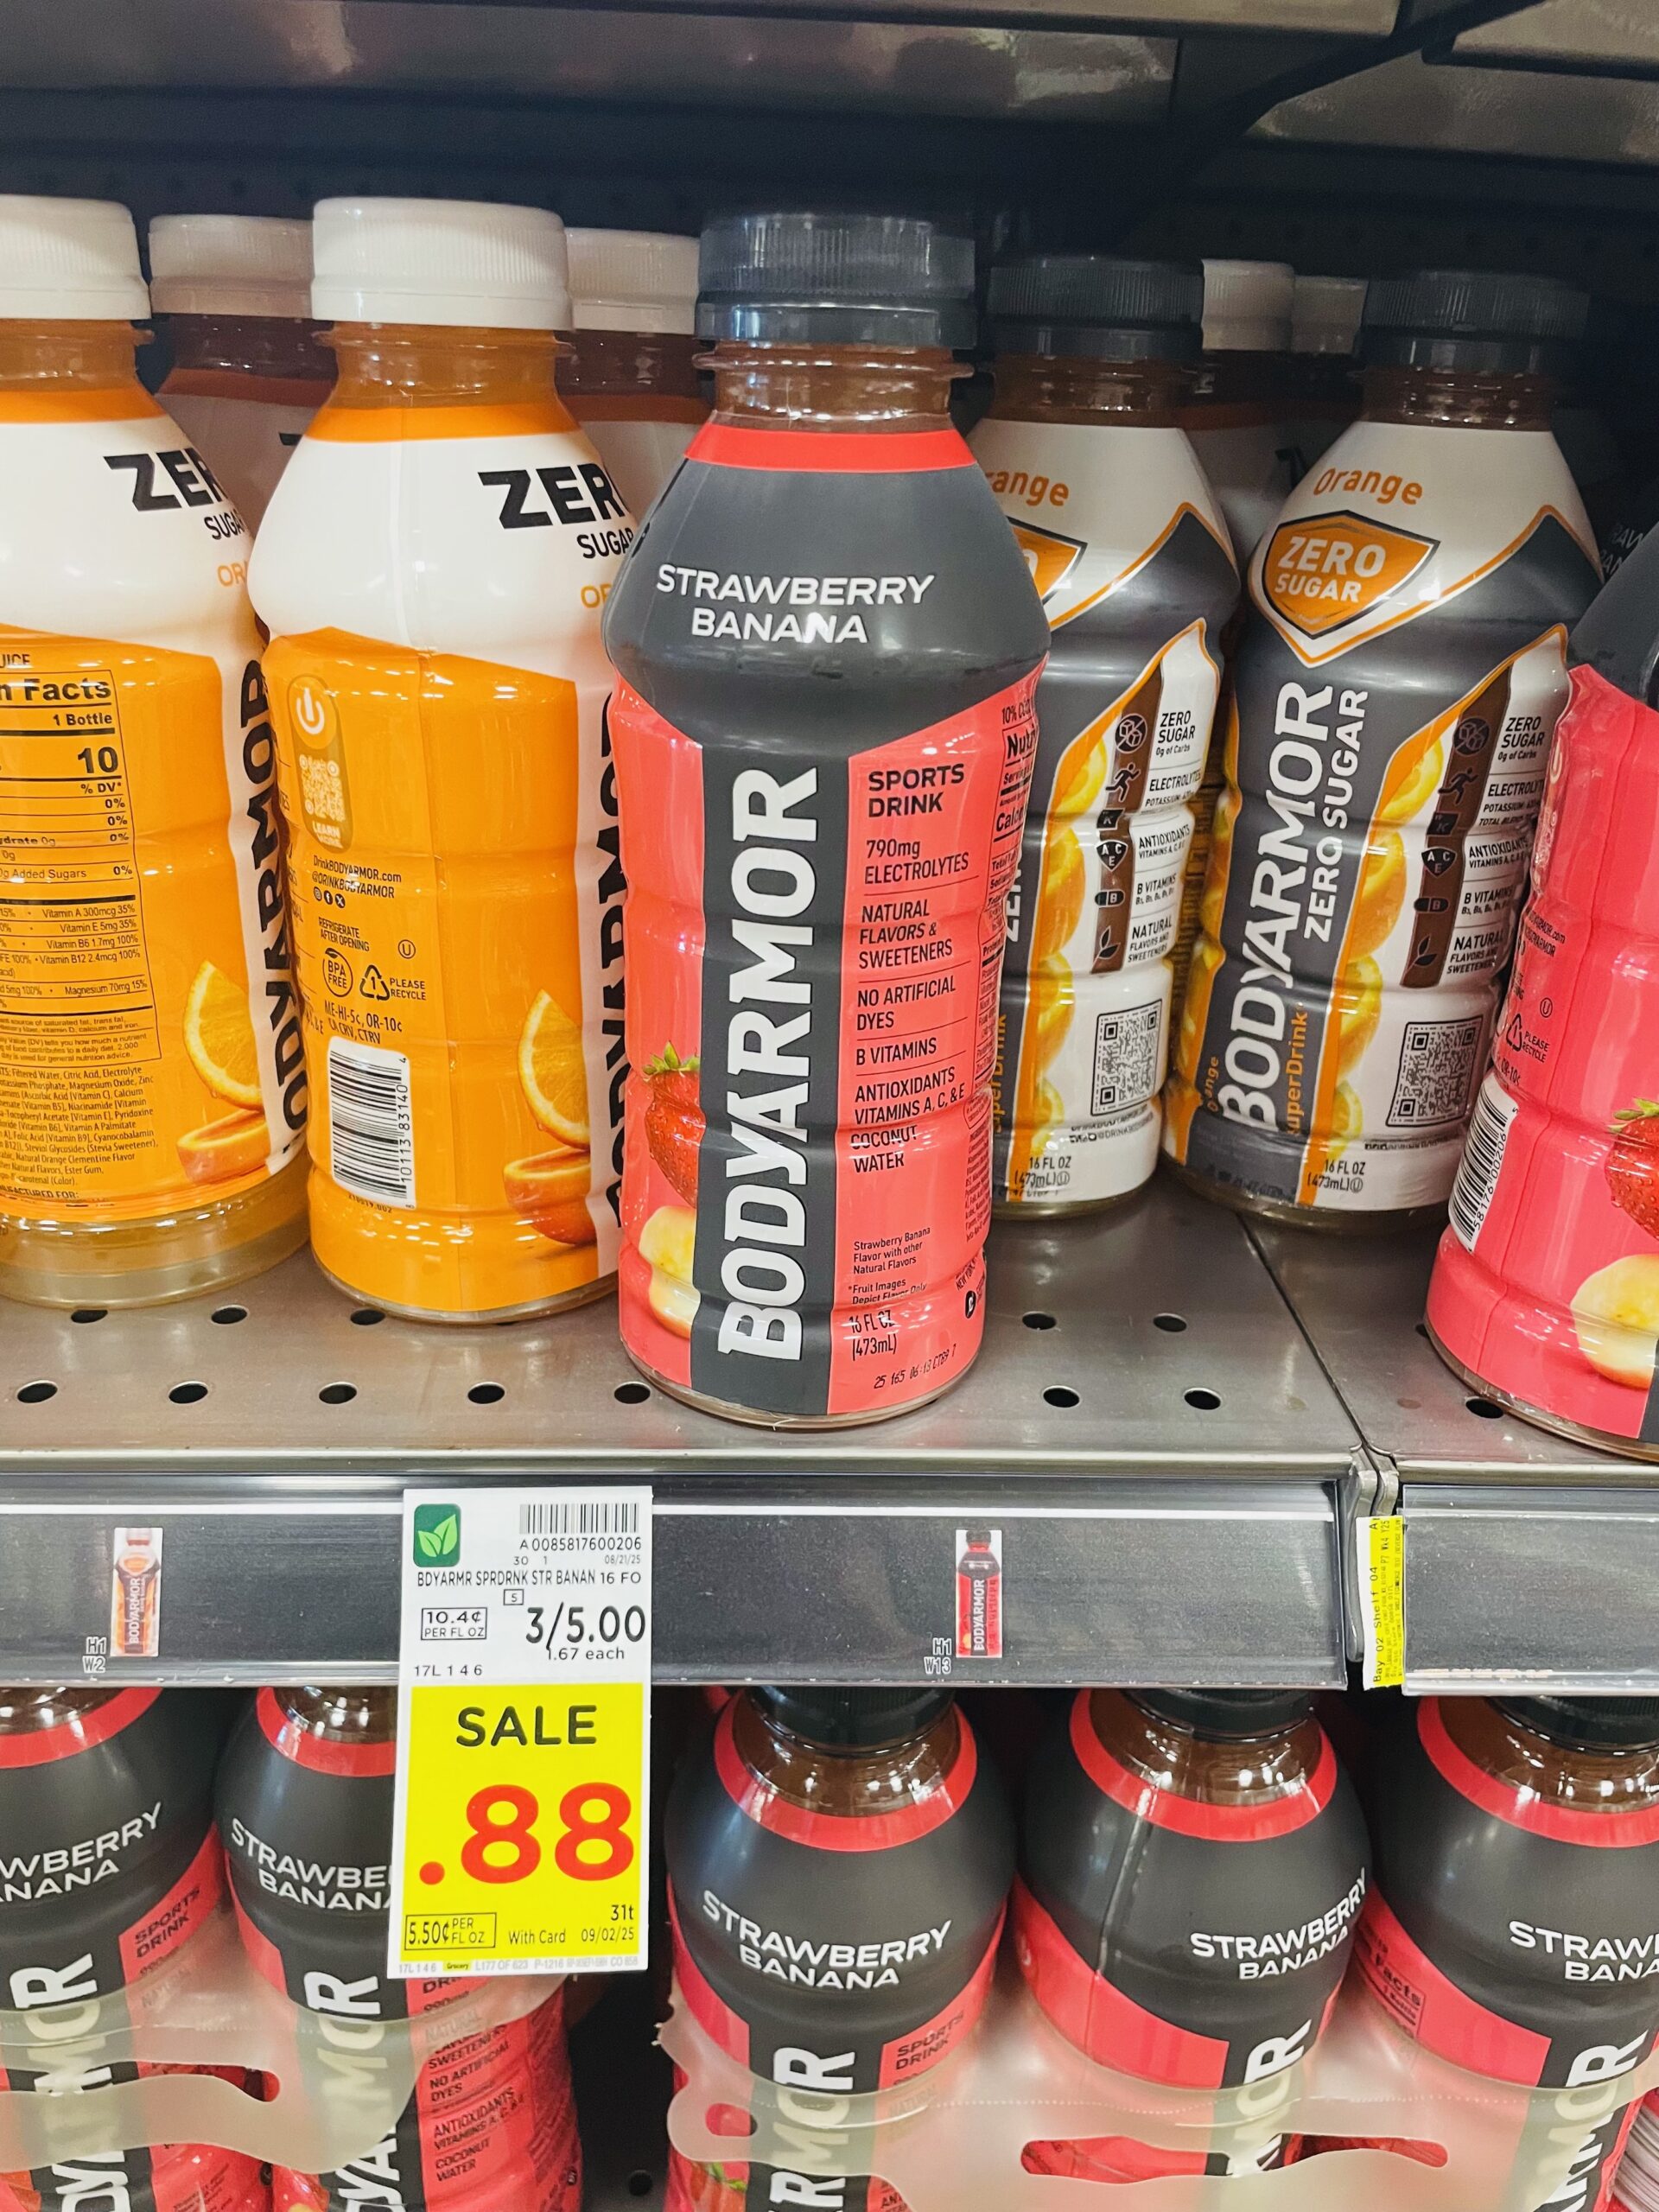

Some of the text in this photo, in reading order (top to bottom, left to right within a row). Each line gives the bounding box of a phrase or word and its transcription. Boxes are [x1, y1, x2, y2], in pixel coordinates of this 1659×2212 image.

[103, 448, 228, 512] ZER
[986, 471, 1070, 506] ange
[1313, 467, 1422, 505] Orange
[479, 464, 630, 530] ZER
[204, 510, 246, 540] SUGA
[1278, 536, 1386, 577] ZERO
[656, 564, 934, 606] STRAWBERRY
[1275, 573, 1362, 603] SUGAR
[690, 607, 868, 645] BANANA
[24, 677, 111, 701] Facts
[53, 713, 112, 726] 1 Bottle
[1160, 710, 1192, 728] ZERO
[1506, 716, 1541, 732] ZERO
[1158, 726, 1196, 743] SUGAR
[1501, 732, 1545, 748] SUGAR
[78, 747, 118, 773] 10
[868, 764, 964, 791] SPORTS
[105, 798, 125, 809] 0%
[868, 792, 944, 818] DRINK
[107, 816, 127, 826] 0%
[1304, 690, 1368, 942] ZERO SUGAR
[110, 833, 129, 842] 0%
[1139, 823, 1191, 849] ANTIOXIDANTS
[866, 838, 920, 860] 790mg
[13, 865, 132, 880] Added Sugars 0%
[314, 855, 402, 883] DrinkBODYARMOR.com
[864, 852, 969, 885] ELECTROLYTES
[1145, 873, 1177, 893] VITAMINS
[1218, 682, 1333, 1132] BODYARMOR
[1474, 888, 1512, 904] VITAMINS
[43, 908, 73, 918] Vitamin
[118, 904, 135, 914] 35%
[861, 899, 930, 923] NATURAL
[60, 923, 91, 933] Vitamin
[119, 918, 137, 929] 35%
[318, 917, 360, 939] REFRIGERATE
[860, 922, 937, 944] FLAVORS &
[1132, 918, 1173, 940] NATURAL
[47, 934, 138, 949] Vitamin 100%
[320, 928, 370, 952] AFTER OPENING
[1453, 931, 1503, 950] NATURAL
[119, 949, 140, 959] 100%
[859, 939, 952, 969] SWEETENERS
[327, 960, 346, 976] BPA
[65, 984, 107, 997] Magnesium
[327, 975, 347, 988] FREE
[390, 977, 425, 989] PLEASE
[857, 976, 956, 1007] NO ARTIFICIAL
[391, 988, 426, 1001] RECYCLE
[856, 1011, 894, 1031] DYES
[856, 1037, 937, 1065] B VITAMINS
[1524, 1031, 1549, 1052] PLEASE
[718, 766, 818, 1361] BODYARMOR
[1286, 1008, 1308, 1136] uperDrink
[855, 1066, 956, 1103] ANTIOXIDANTS
[855, 1100, 920, 1125] VITAMINS
[396, 1084, 413, 1183] 10113 83140
[850, 1125, 918, 1150] COCONUT
[853, 1152, 905, 1173] WATER
[1042, 1156, 1055, 1169] FL
[1058, 1156, 1071, 1169] OZ
[1337, 1161, 1351, 1174] FL
[1352, 1161, 1365, 1175] OZ
[1473, 1133, 1506, 1230] 58176 00206
[854, 1227, 931, 1251] Strawberry Banana
[854, 1242, 923, 1263] Flavor with other
[853, 1255, 917, 1274] Natural Flavors
[875, 1278, 906, 1293] Images
[852, 1294, 880, 1305] Depict
[864, 1313, 878, 1332] FL
[852, 1333, 897, 1361] (473mL)
[520, 1536, 641, 1550] A 0085817600206
[513, 1554, 640, 1565] 30 08/21/25
[417, 1569, 641, 1586] BDYARMR SPRDRNK STR BANAN 16 FO
[130, 1578, 141, 1644] BODYARMOR
[973, 1579, 985, 1651] BODYARMOR
[1371, 1590, 1382, 1629] Shelf
[424, 1628, 485, 1637] PER FL OZ
[427, 1602, 645, 1650] 10.4¢ 3/5.00
[86, 1637, 106, 1655] H1
[548, 1647, 625, 1661] 1.67 each
[932, 1637, 951, 1655] H1
[1376, 1637, 1383, 1652] 02
[82, 1656, 105, 1673] W2
[414, 1665, 441, 1676] 17L
[924, 1656, 951, 1675] W13
[1372, 1661, 1386, 1682] Bay
[456, 1705, 597, 1747] SALE
[0, 1802, 162, 1879] WBERRY
[419, 1782, 634, 1885] .88
[232, 1817, 391, 1889] STRAWBE
[0, 1859, 120, 1902] NANA
[611, 1904, 634, 1921] 31t
[1190, 1866, 1366, 1960] STRAWBERRY
[409, 1918, 473, 1945] 5.50¢ PER
[452, 1927, 634, 1945] FL OZ With Card 09/02/25
[702, 1890, 951, 1967] STRAWBERRY
[1509, 1920, 1659, 1961] STRAW
[1239, 1926, 1349, 1980] BANANA
[447, 1962, 468, 1971] Grocery
[740, 1944, 899, 1990] BANANA
[1565, 1958, 1659, 1982] BANA
[898, 2010, 964, 2057] SPORTS
[895, 2037, 949, 2071] DRINK
[430, 2075, 448, 2089] NO
[431, 2083, 462, 2102] DYES
[434, 2087, 515, 2138] ANTIOXIDANTS
[435, 2137, 490, 2170] COCONUT
[436, 2159, 477, 2182] WATER
